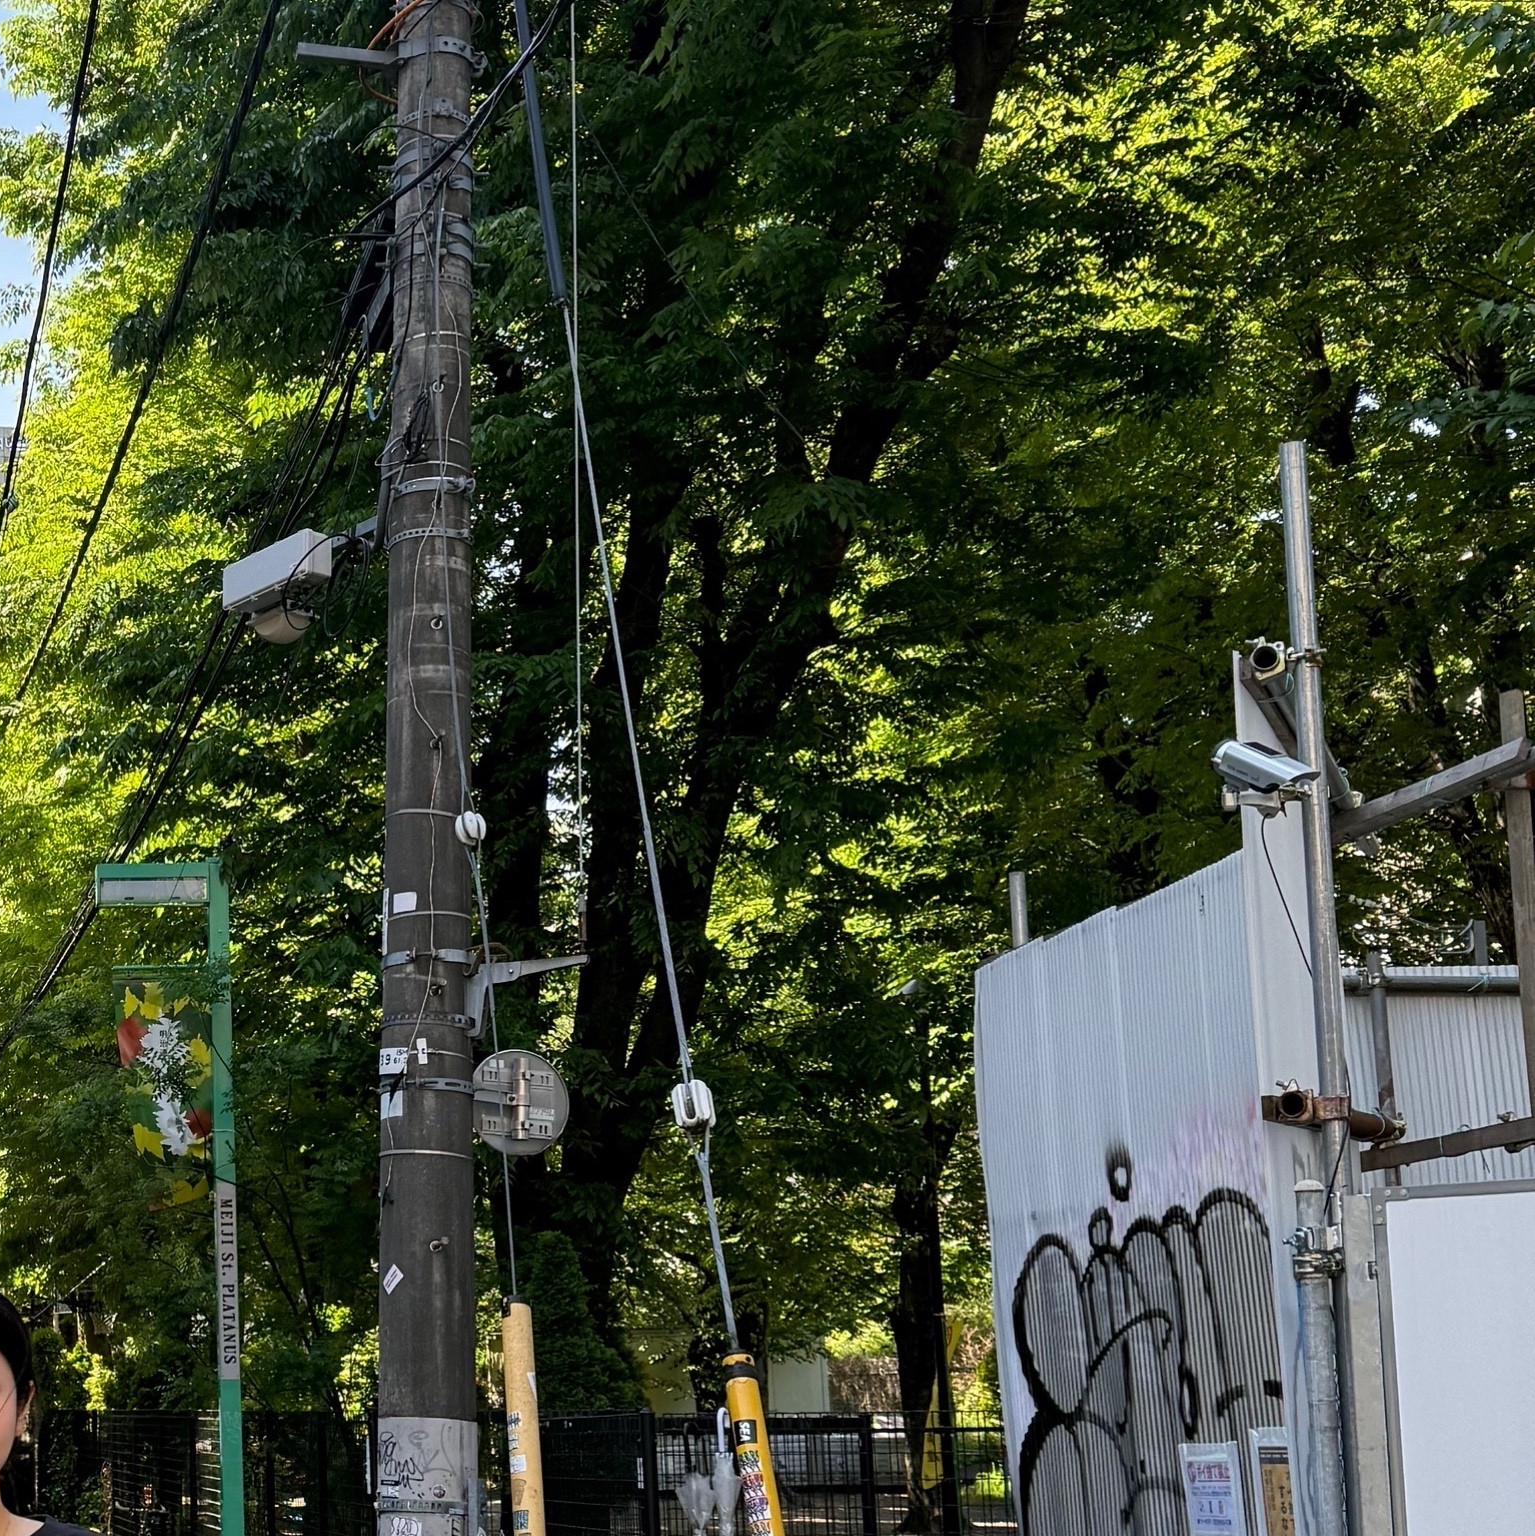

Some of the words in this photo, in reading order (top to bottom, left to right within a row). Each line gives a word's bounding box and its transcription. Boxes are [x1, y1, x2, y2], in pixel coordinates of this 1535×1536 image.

[220, 1198, 234, 1246] MEIJI
[221, 1252, 235, 1277] St.
[222, 1283, 237, 1366] PLATANUS
[739, 1421, 752, 1443] SEA
